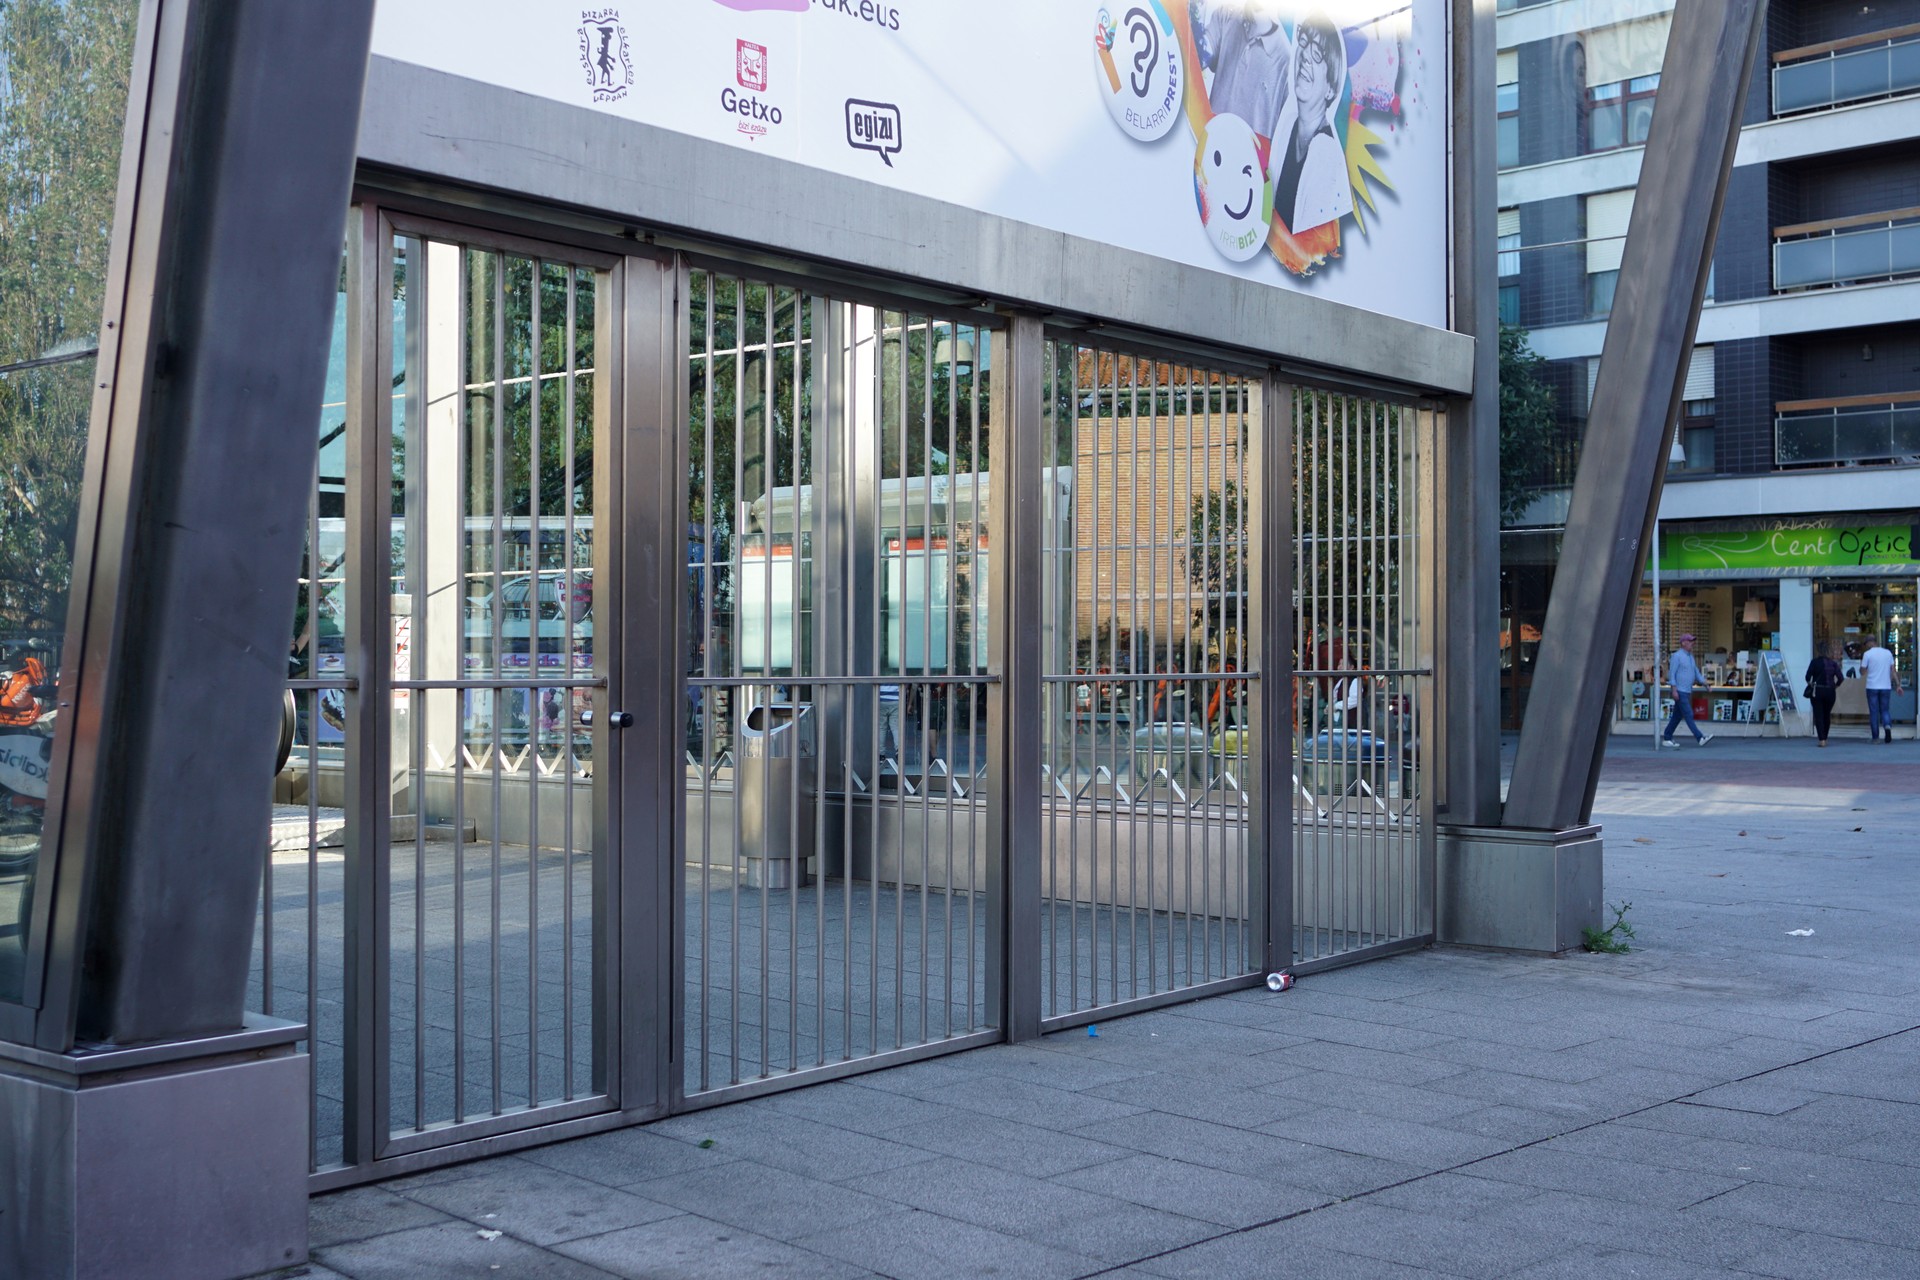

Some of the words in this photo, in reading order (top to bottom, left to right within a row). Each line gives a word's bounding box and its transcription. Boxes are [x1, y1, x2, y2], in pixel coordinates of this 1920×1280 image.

[812, 0, 900, 31] k.eus
[721, 87, 782, 125] Getxo
[854, 111, 893, 142] egizu
[1771, 532, 1838, 556] Centr
[1839, 527, 1913, 566] Óptic
